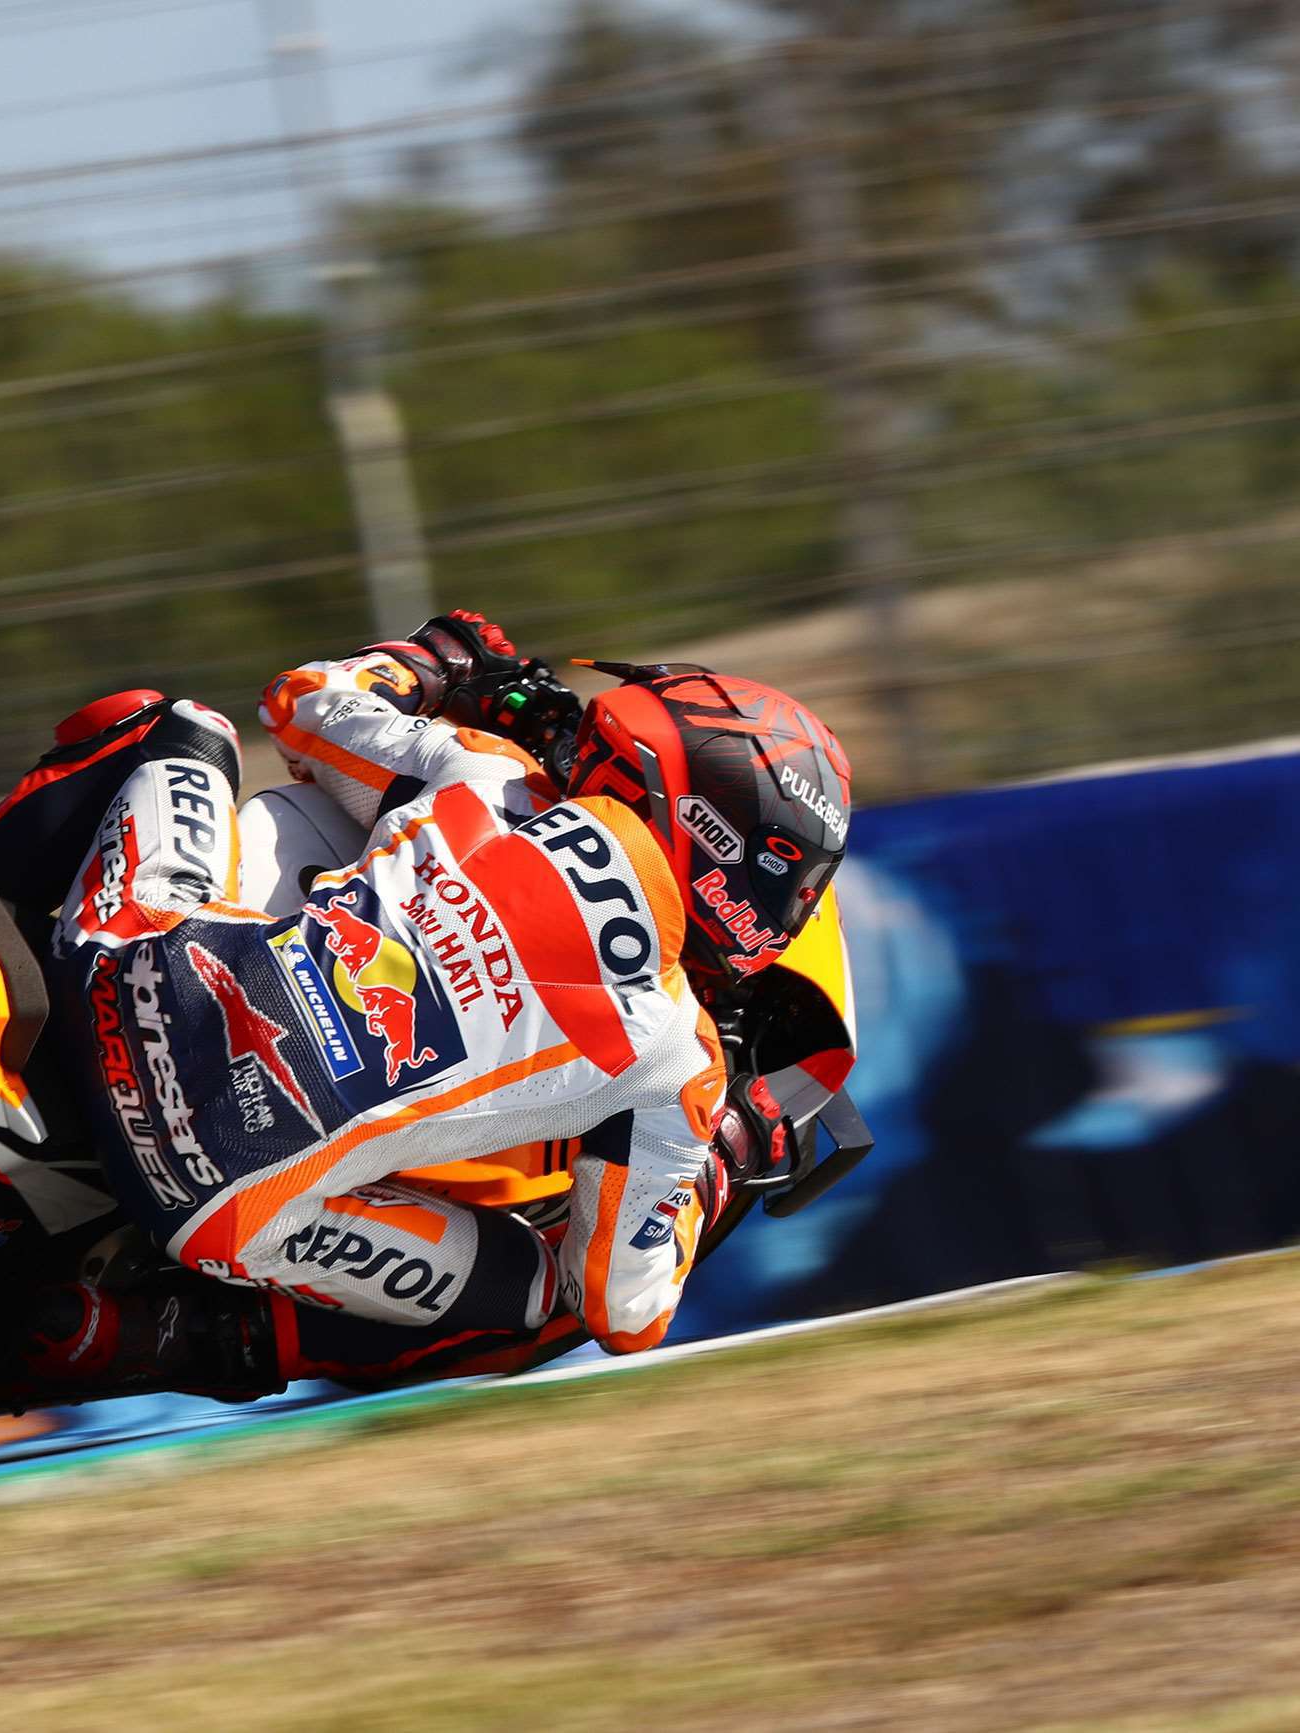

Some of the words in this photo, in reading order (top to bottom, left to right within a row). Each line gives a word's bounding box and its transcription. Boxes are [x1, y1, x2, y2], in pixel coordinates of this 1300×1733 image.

[682, 803, 739, 858] SHOEI
[761, 854, 785, 873] SHOEI
[400, 893, 442, 935] Satu
[412, 852, 524, 1033] HONDA
[516, 807, 655, 1016] EPSOL
[295, 970, 348, 1061] MICHELIN
[88, 952, 196, 1210] MARQUEZ
